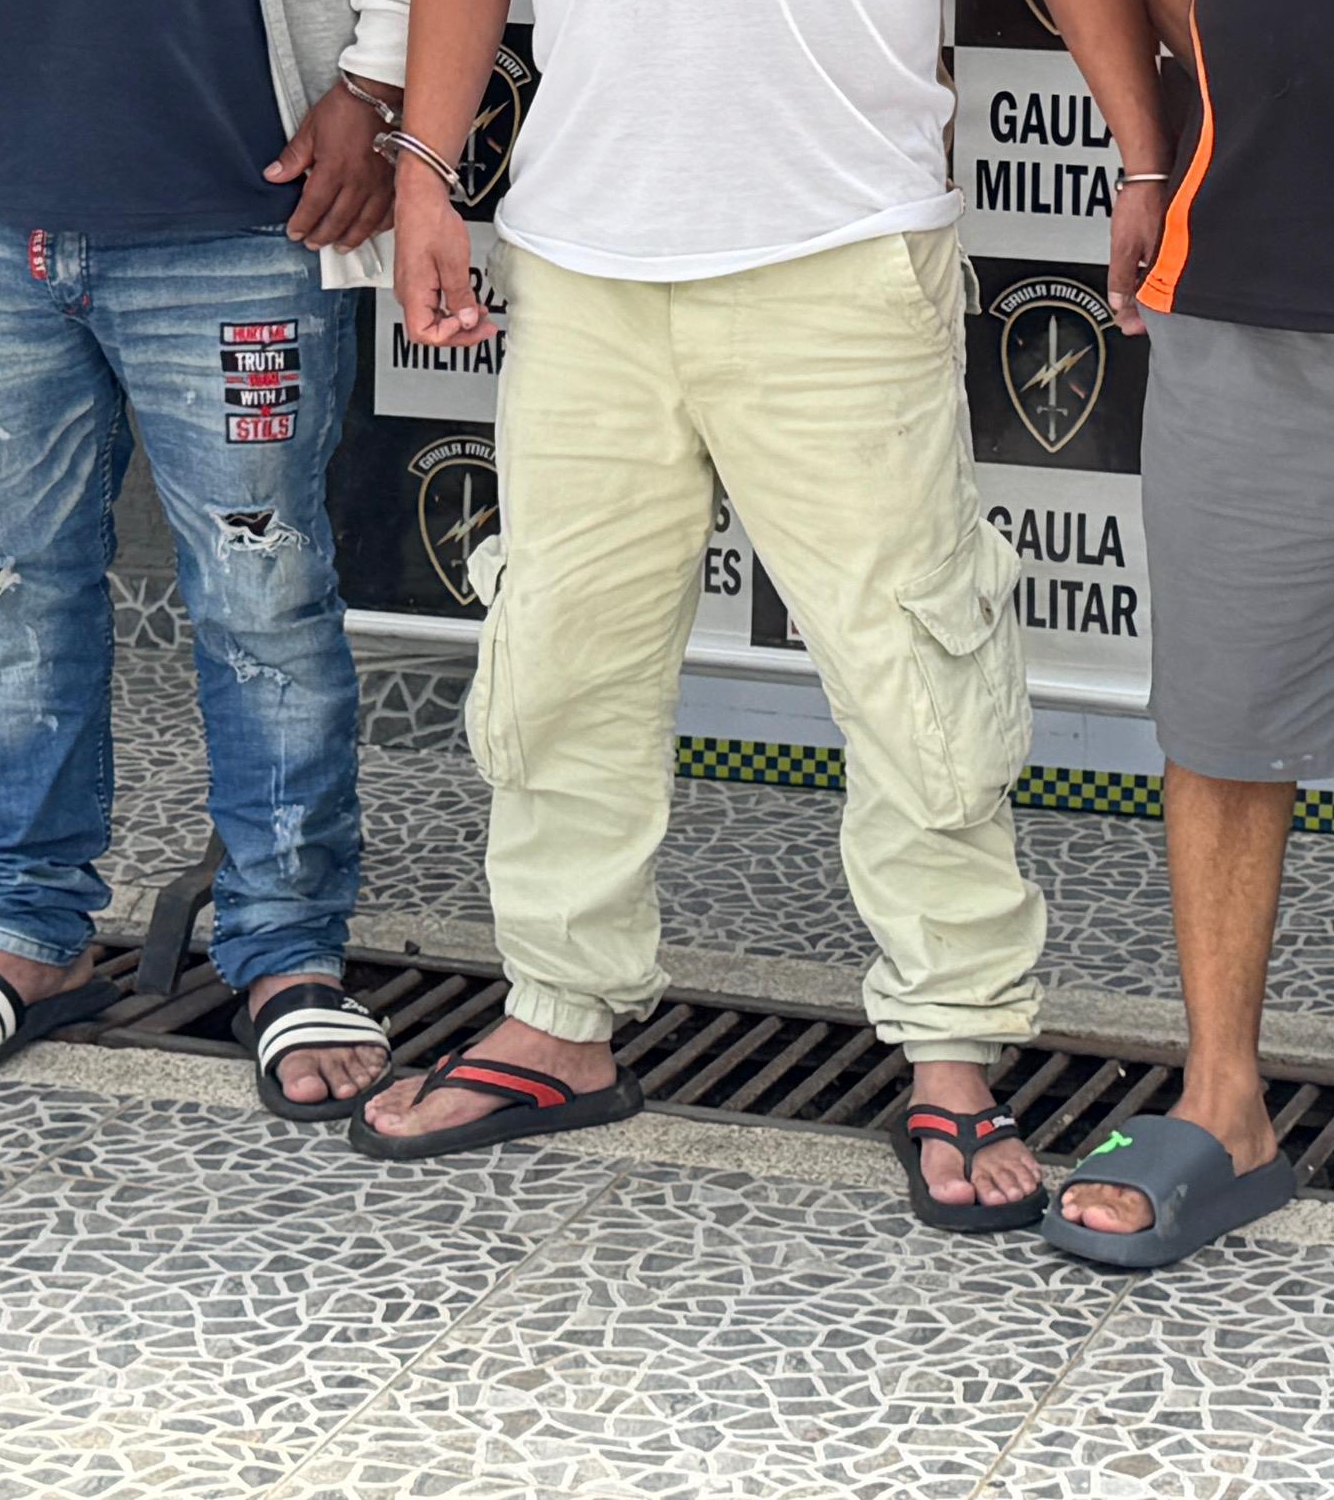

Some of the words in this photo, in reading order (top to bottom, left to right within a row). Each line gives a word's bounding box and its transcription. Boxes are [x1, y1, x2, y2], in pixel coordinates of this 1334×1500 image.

[975, 160, 1116, 218] MILITA
[235, 351, 284, 371] TRUTH
[240, 389, 276, 406] WITH
[986, 505, 1124, 568] GAULA
[1014, 578, 1138, 637] ILITAR
